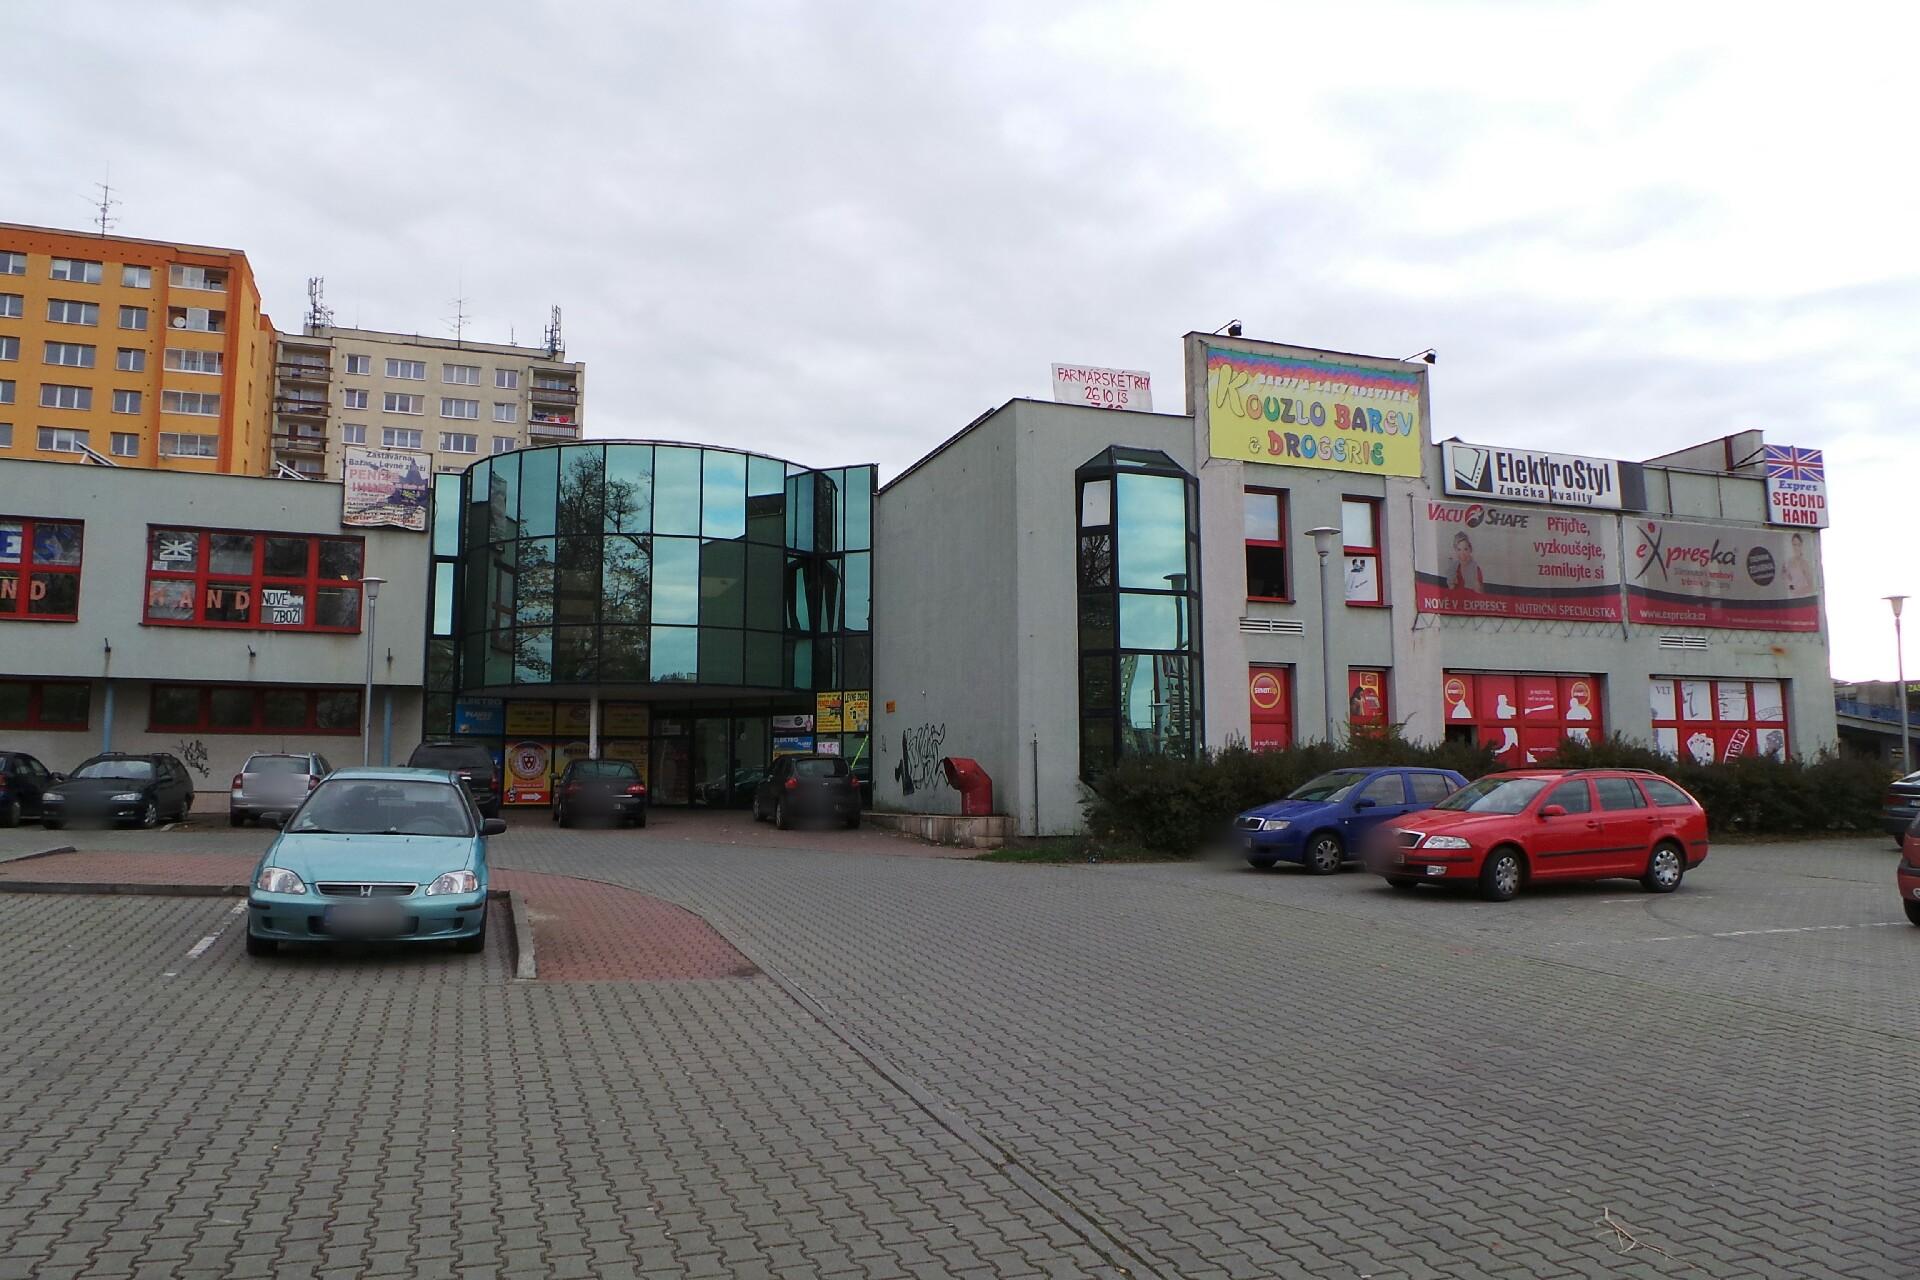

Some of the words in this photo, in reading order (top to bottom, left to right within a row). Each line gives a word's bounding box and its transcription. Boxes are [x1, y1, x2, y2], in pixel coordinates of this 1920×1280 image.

[1216, 364, 1326, 427] KOUZLO
[1334, 403, 1413, 437] BAREV
[1267, 430, 1385, 466] DROGERIE
[1496, 452, 1611, 497] ElektroStyl
[1499, 485, 1545, 499] Značka
[1551, 489, 1593, 504] kvality
[1778, 480, 1818, 491] Expres
[1772, 491, 1825, 509] SECOND
[1427, 503, 1463, 523] VACU
[1485, 508, 1529, 529] SHAPE
[1782, 508, 1818, 524] HAND
[1533, 538, 1606, 560] vyzkoušejte,
[1538, 562, 1592, 581] zamilujte
[1594, 565, 1605, 580] si
[263, 590, 290, 607] NOVÉ
